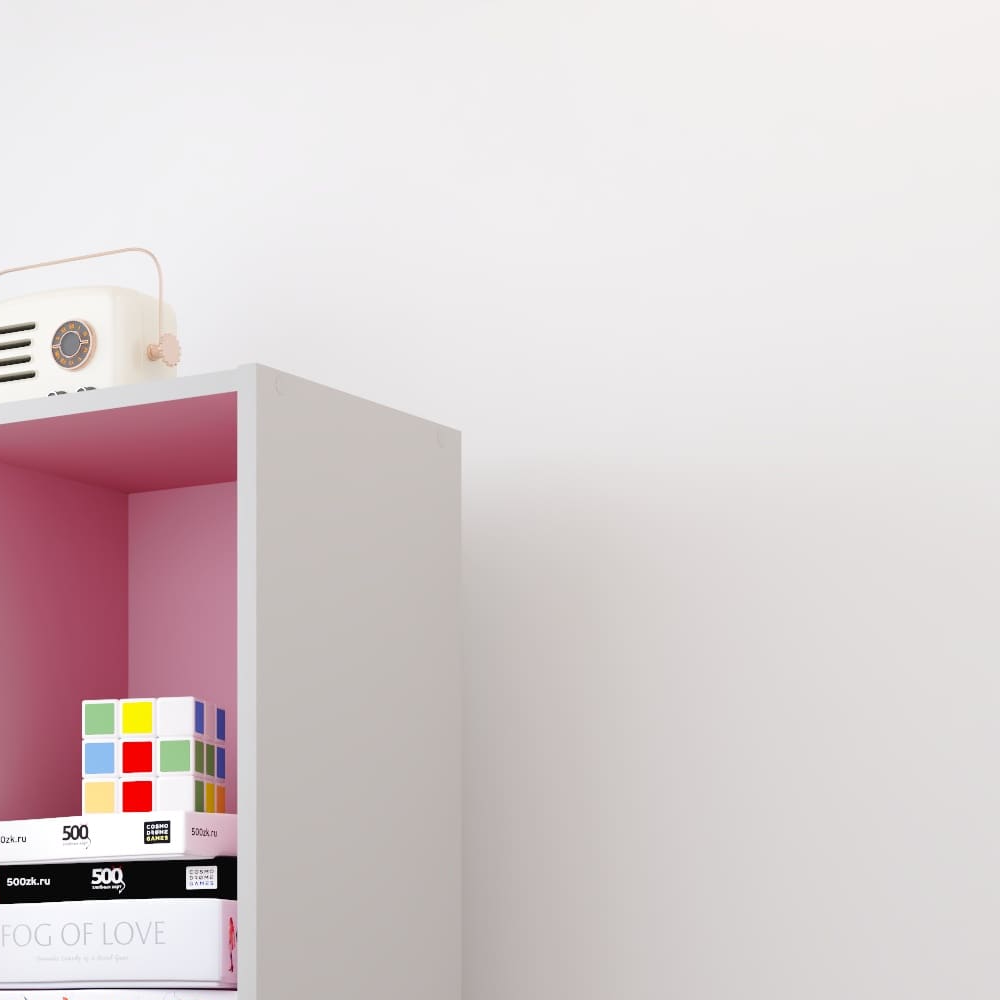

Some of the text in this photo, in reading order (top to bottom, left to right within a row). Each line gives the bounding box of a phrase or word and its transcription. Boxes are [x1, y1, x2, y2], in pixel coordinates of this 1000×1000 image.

[62, 824, 89, 841] 500
[191, 827, 218, 838] 500zk.ru
[6, 876, 51, 887] 500zk.ru
[91, 867, 124, 885] 500
[1, 920, 167, 948] FOG OF LOVE
